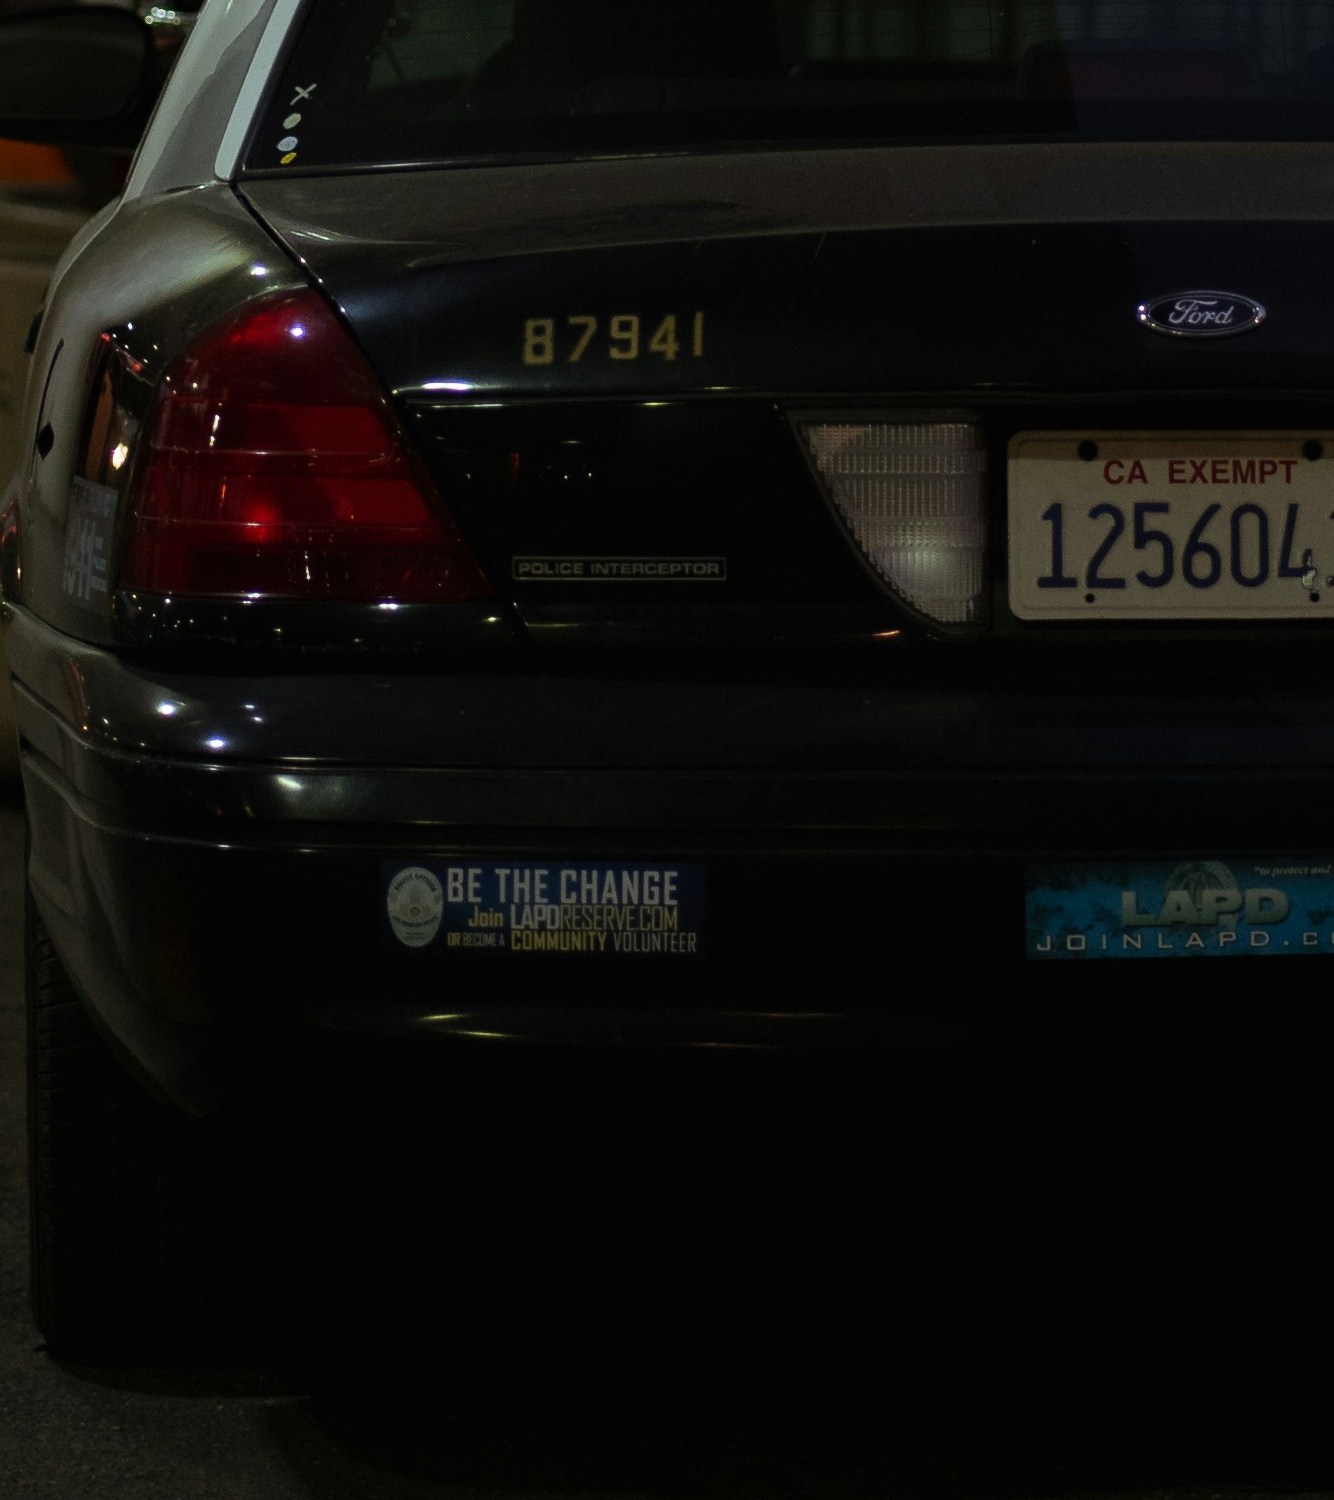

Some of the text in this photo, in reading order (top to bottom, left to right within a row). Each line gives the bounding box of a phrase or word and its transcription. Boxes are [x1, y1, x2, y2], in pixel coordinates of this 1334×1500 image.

[1169, 299, 1234, 324] Ford
[523, 311, 704, 365] 87941
[1103, 459, 1298, 484] CA EXEMPT
[518, 562, 720, 574] POLICE INTERCEPTOR
[447, 868, 678, 905] BE THE CHANGE
[468, 904, 503, 928] Join
[511, 904, 678, 931] LAPDRESERVE.COM
[1121, 888, 1290, 926] LAPD
[447, 933, 461, 947] OR
[463, 933, 497, 947] BECOME
[511, 931, 607, 951] COMMUNITY
[613, 932, 697, 953] VOLUNTEER
